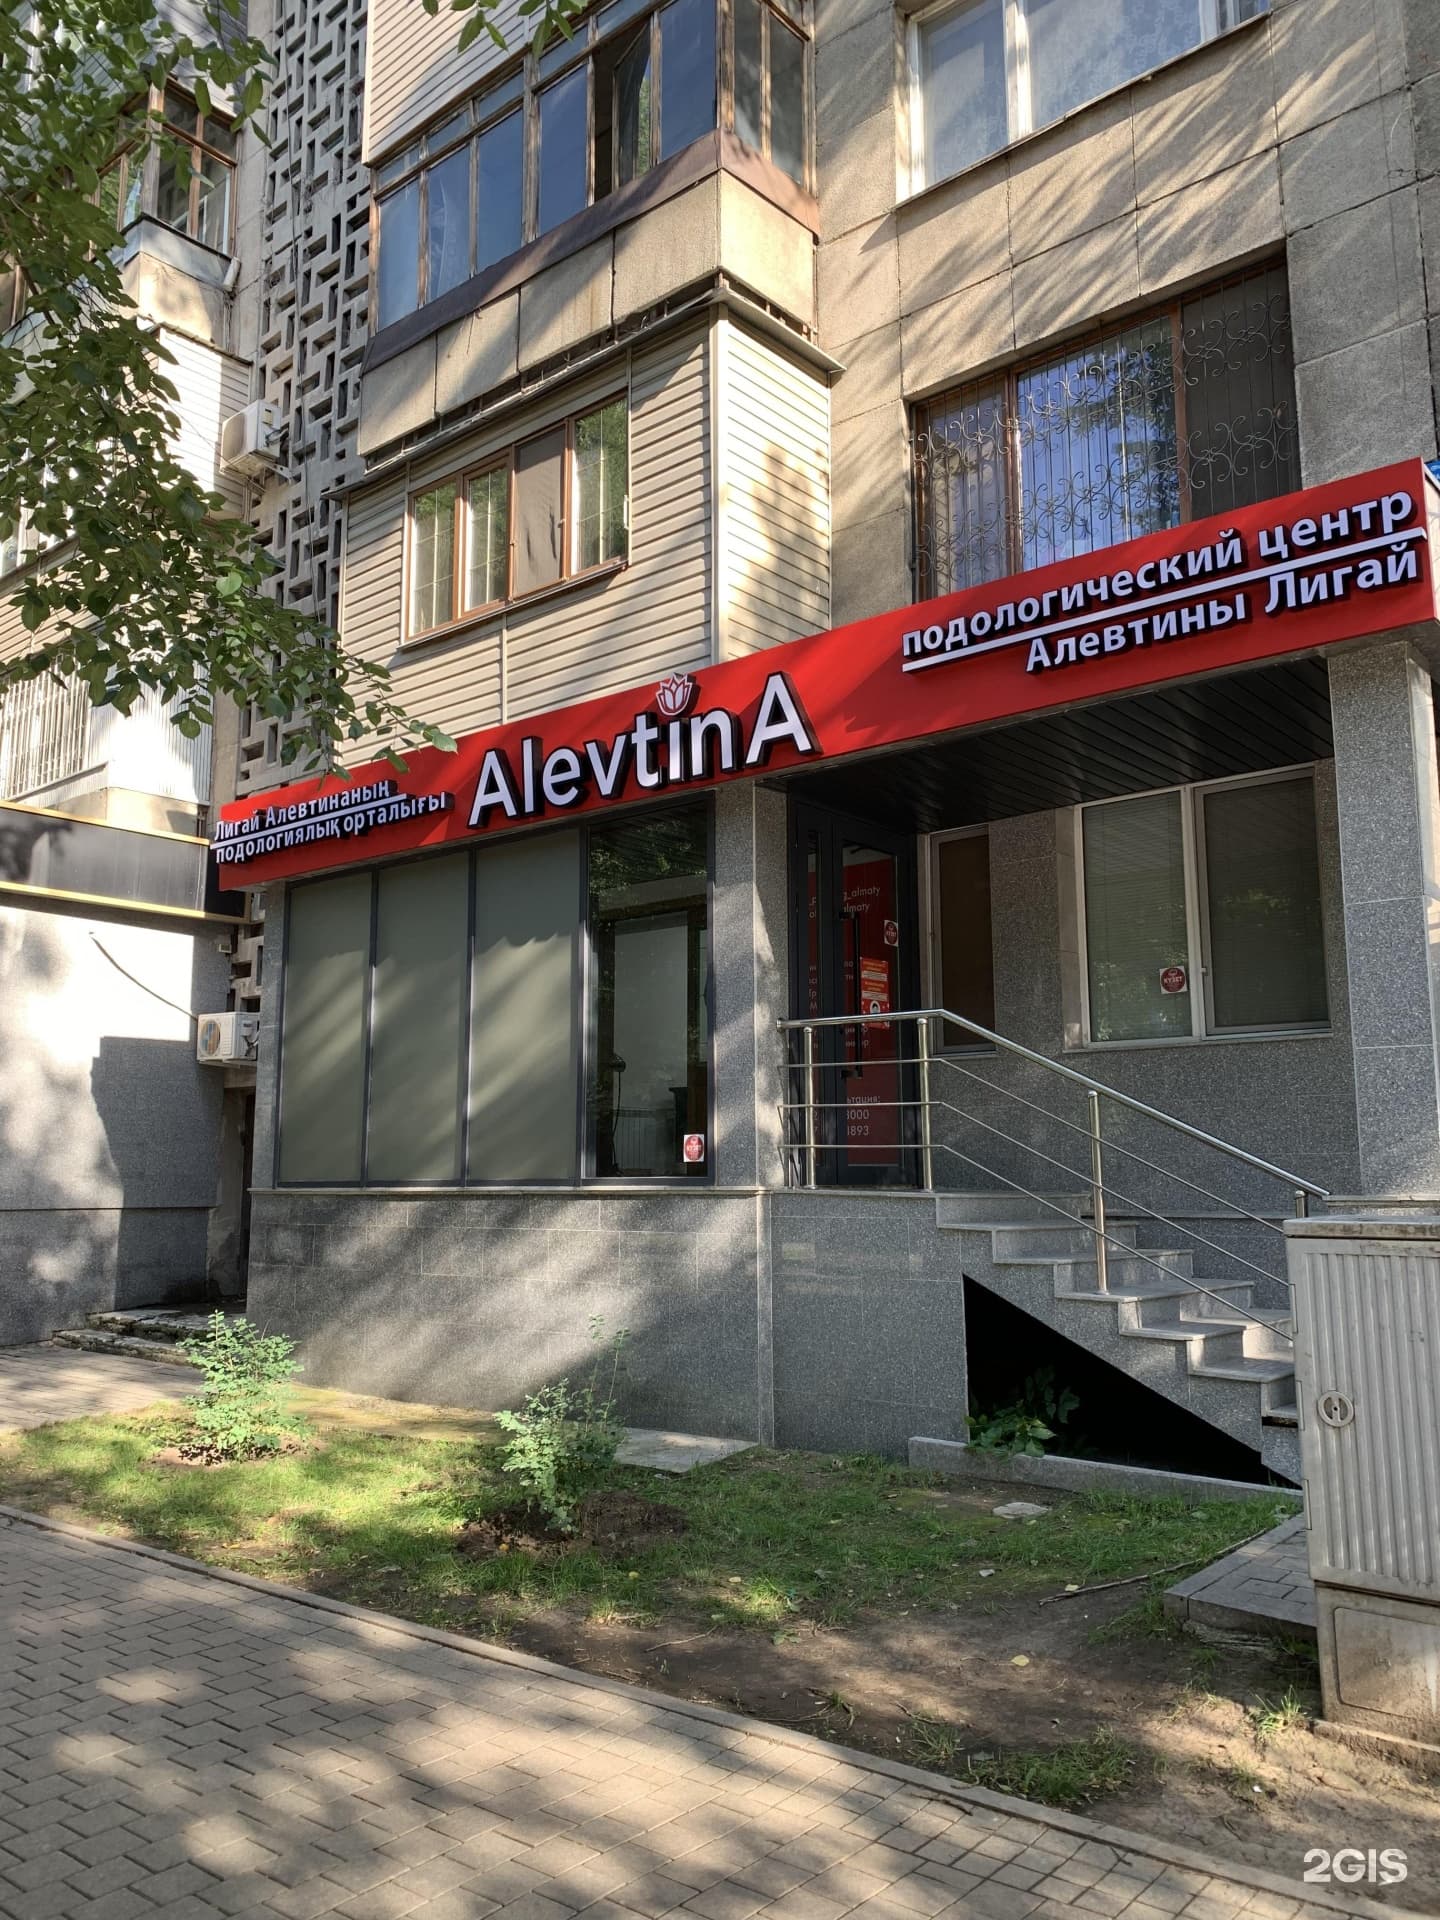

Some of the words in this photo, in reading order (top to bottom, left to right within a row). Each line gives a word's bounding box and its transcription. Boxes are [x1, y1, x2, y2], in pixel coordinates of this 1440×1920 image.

[902, 531, 1243, 657] подологический
[1257, 490, 1413, 561] центр
[1025, 590, 1245, 673] Алевтины
[1264, 542, 1418, 614] Лигай
[214, 809, 260, 841] Лигай
[265, 779, 390, 827] Алевтинаның
[468, 673, 813, 826] AlevtinA
[216, 819, 341, 864] подологиялық
[343, 792, 446, 836] орталығы
